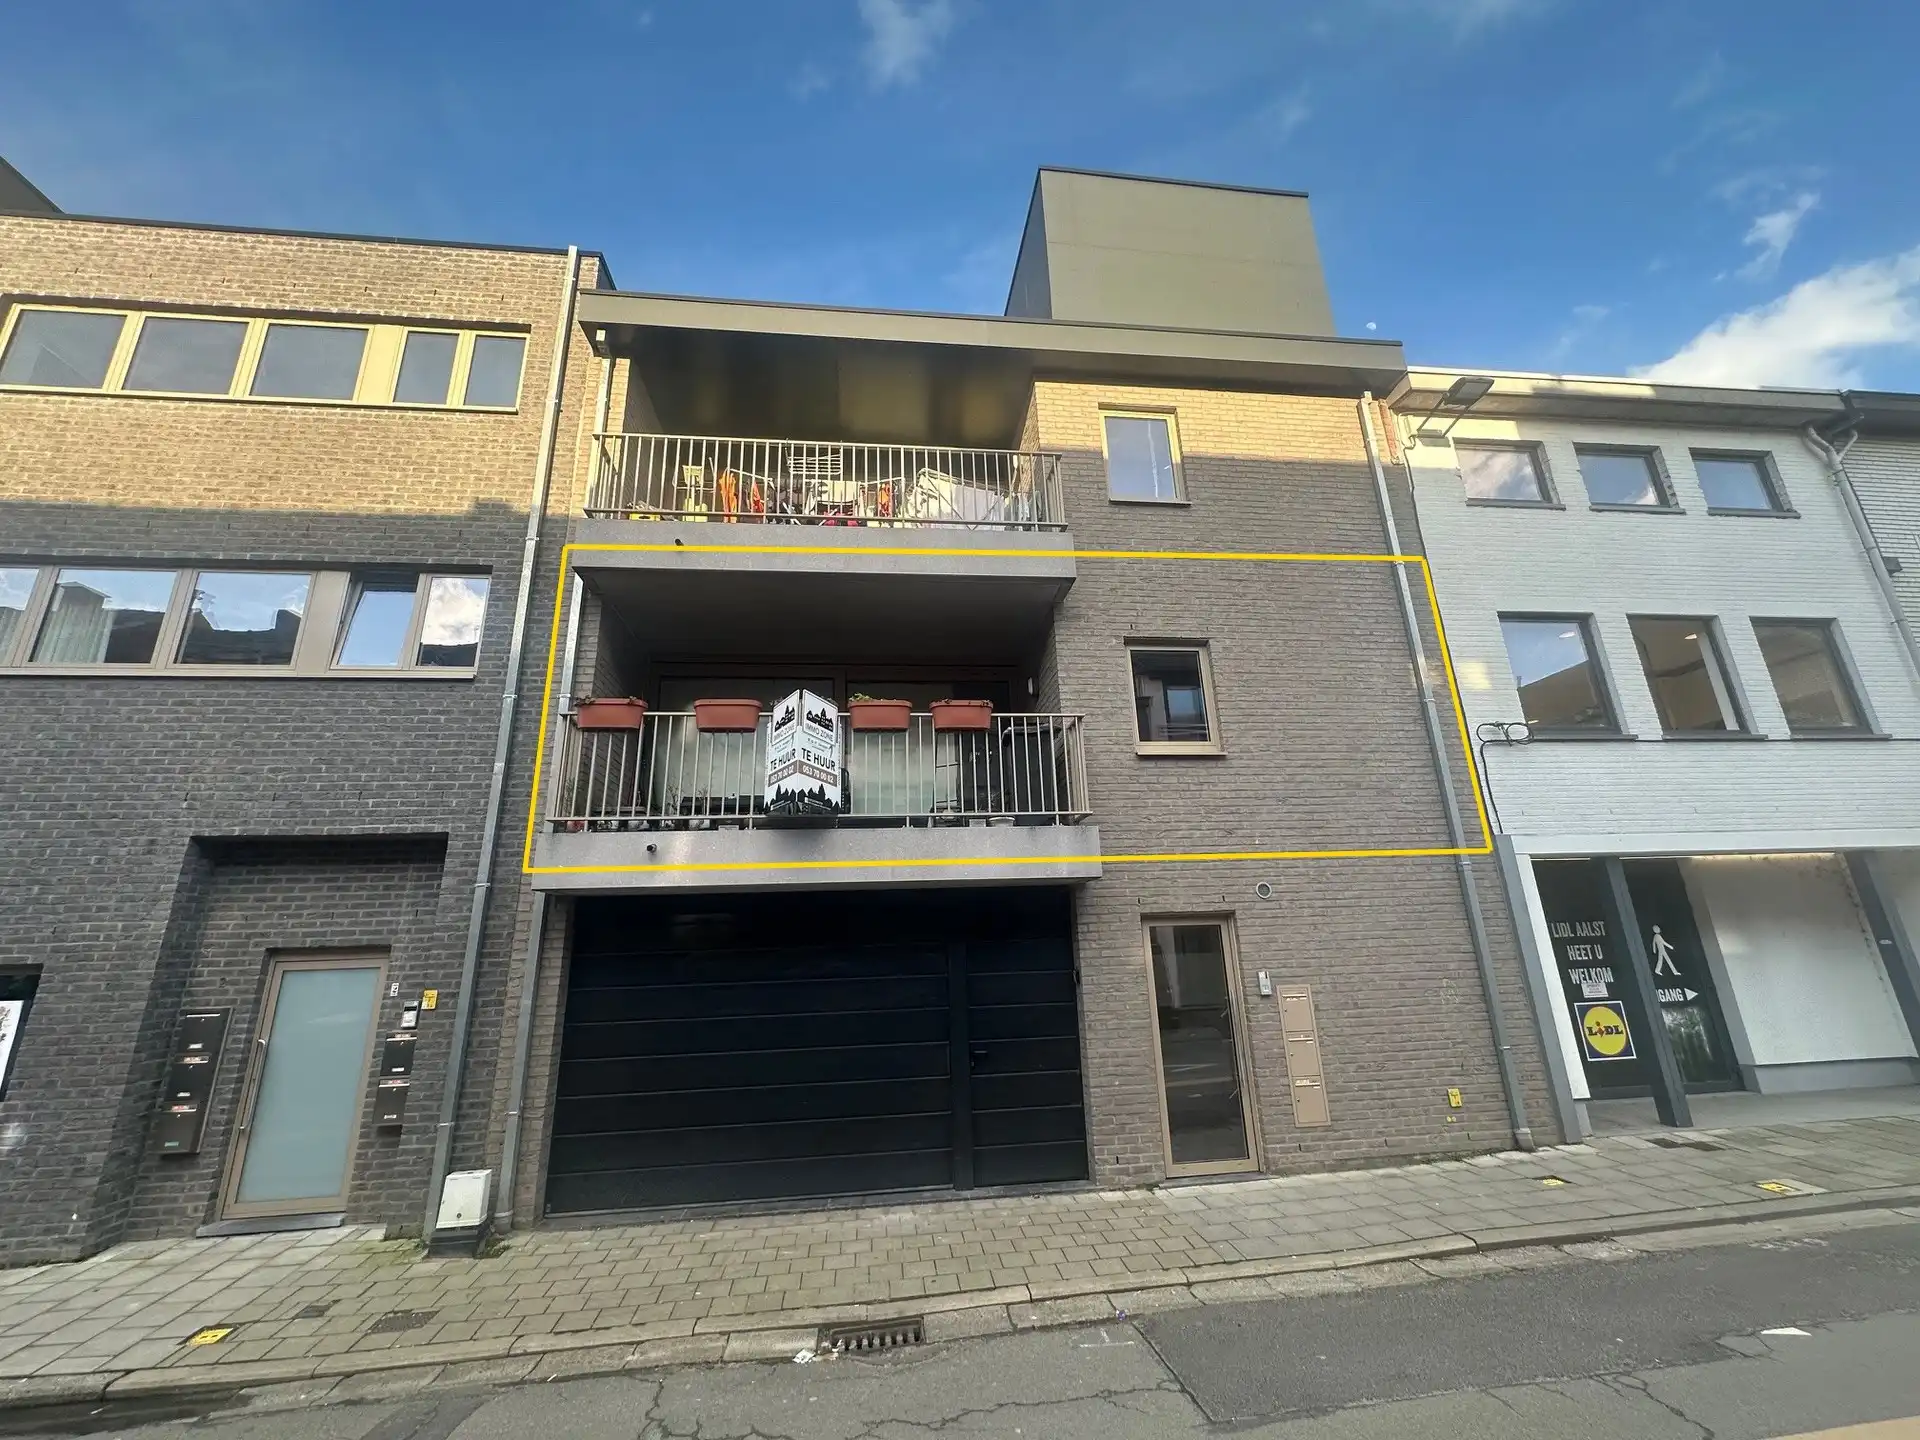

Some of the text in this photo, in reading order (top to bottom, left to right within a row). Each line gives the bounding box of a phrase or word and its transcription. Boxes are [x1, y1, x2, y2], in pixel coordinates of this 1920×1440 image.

[770, 748, 796, 771] TE HUUR
[801, 747, 836, 771] TE HUUR
[1551, 921, 1606, 938] LIDL AALST
[1566, 944, 1603, 961] HEET U
[1568, 967, 1614, 985] WELKOM
